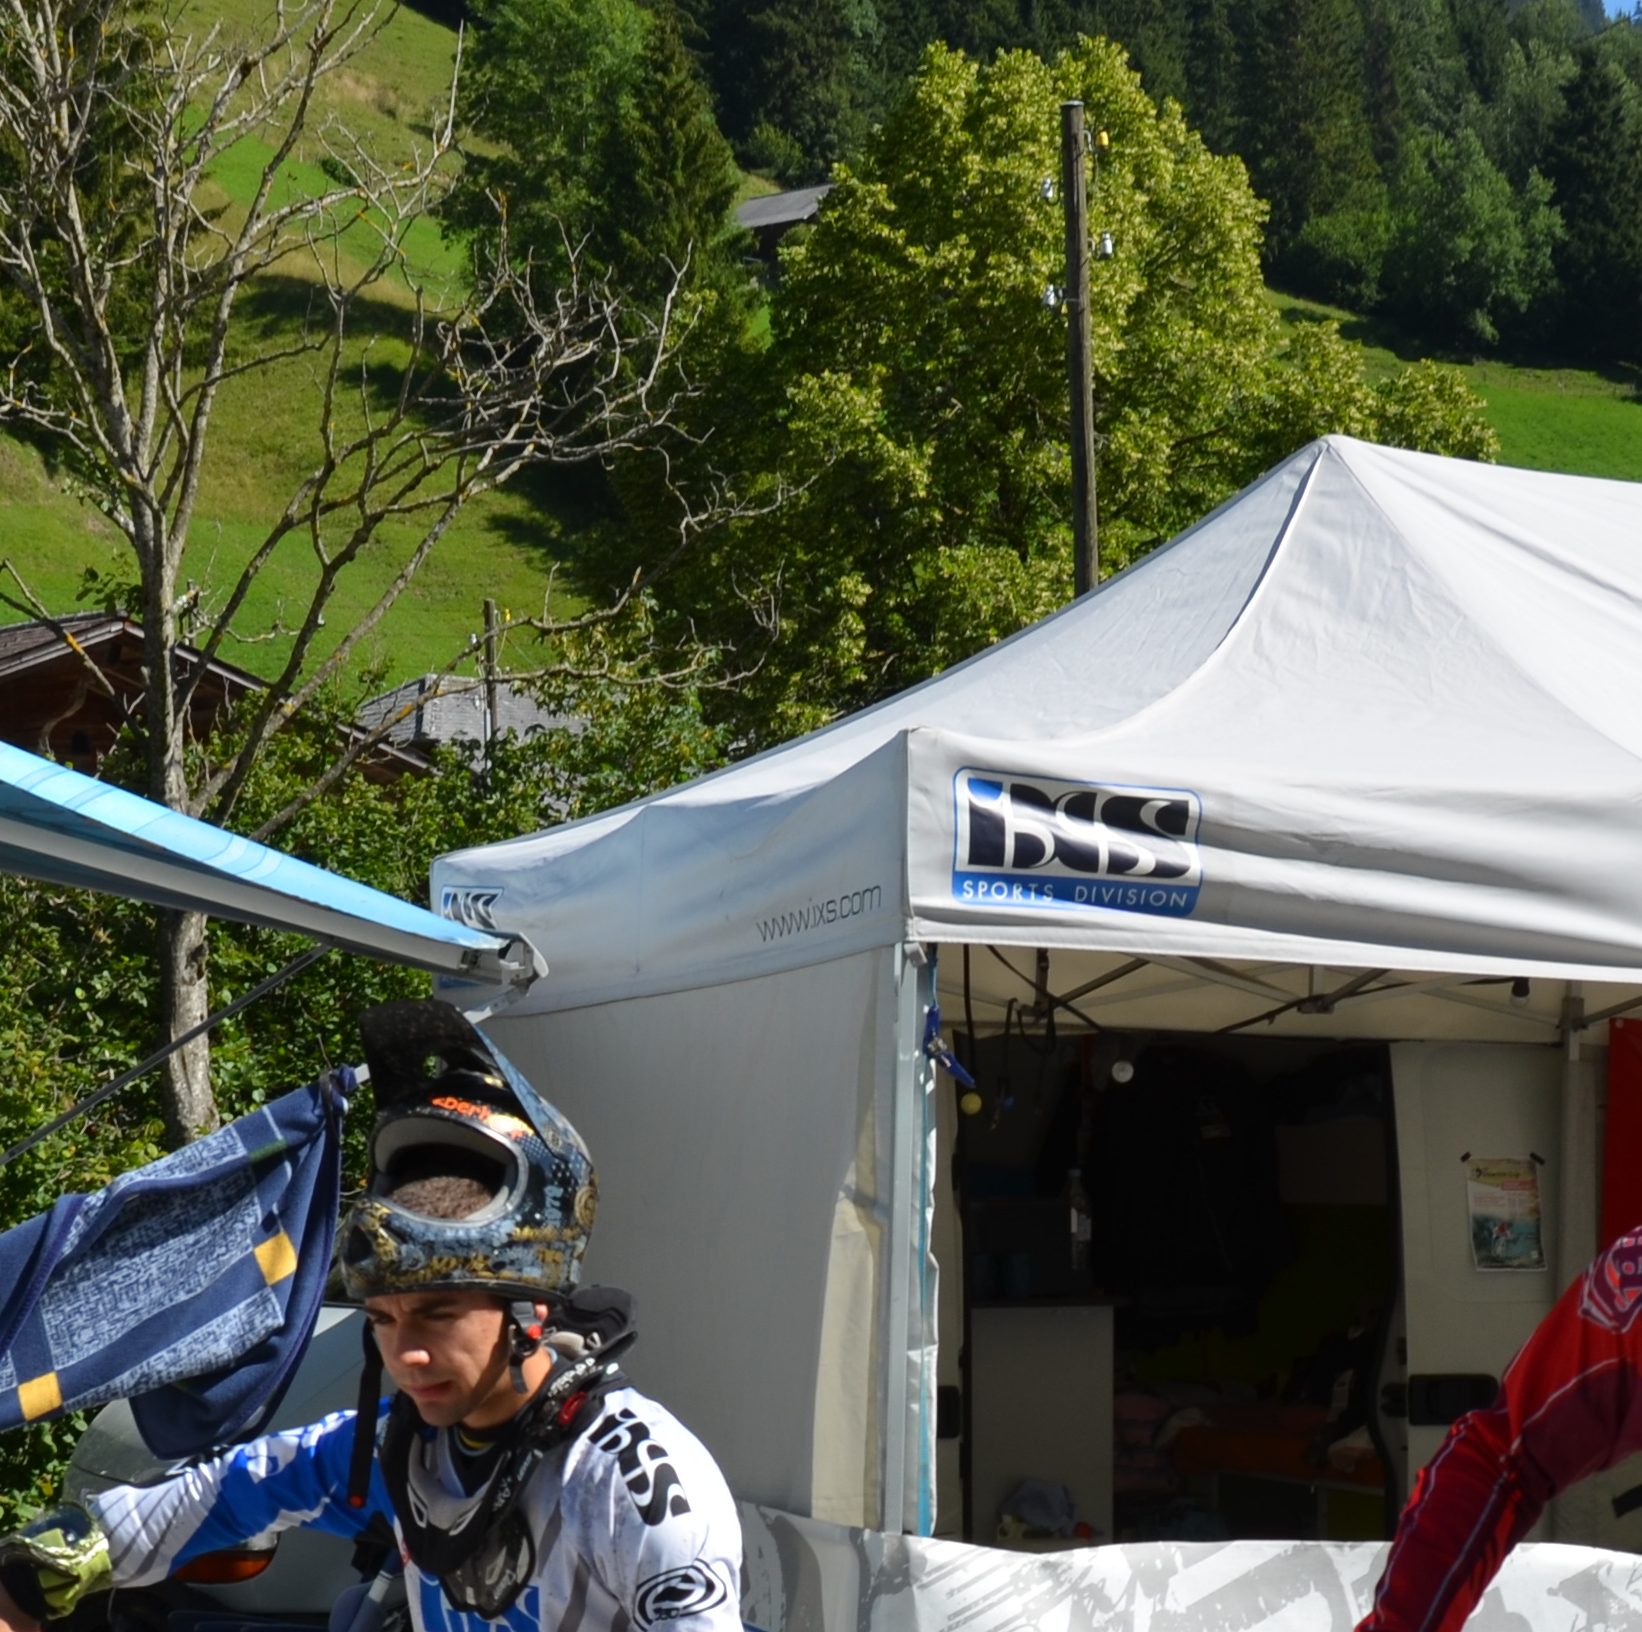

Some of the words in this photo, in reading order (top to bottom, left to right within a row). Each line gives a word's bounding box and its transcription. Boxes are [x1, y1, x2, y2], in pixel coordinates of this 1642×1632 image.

[757, 882, 883, 943] www.ixs.com
[961, 879, 1055, 904] SPORTS
[1073, 885, 1188, 910] DIVISION
